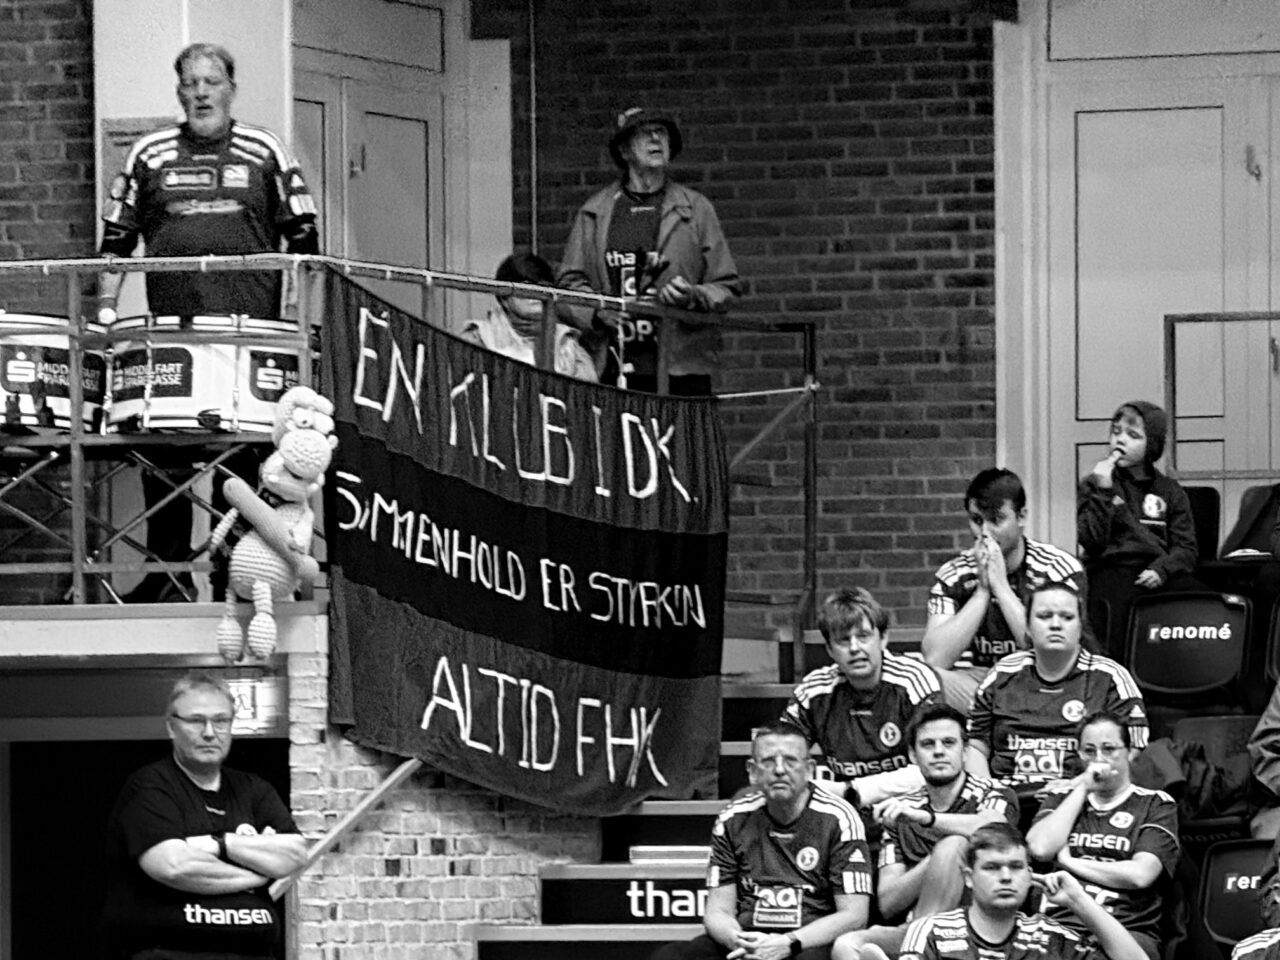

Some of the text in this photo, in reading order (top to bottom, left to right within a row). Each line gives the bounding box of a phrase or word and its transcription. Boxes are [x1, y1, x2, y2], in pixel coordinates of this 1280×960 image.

[353, 307, 425, 435] EN
[448, 366, 575, 485] KLUB
[592, 404, 611, 498] I
[540, 558, 581, 613] ER
[1148, 621, 1233, 642] renomé
[420, 656, 669, 787] ALTID FHK
[1007, 733, 1079, 752] thansen
[826, 754, 907, 778] thansen
[183, 903, 272, 925] thansen
